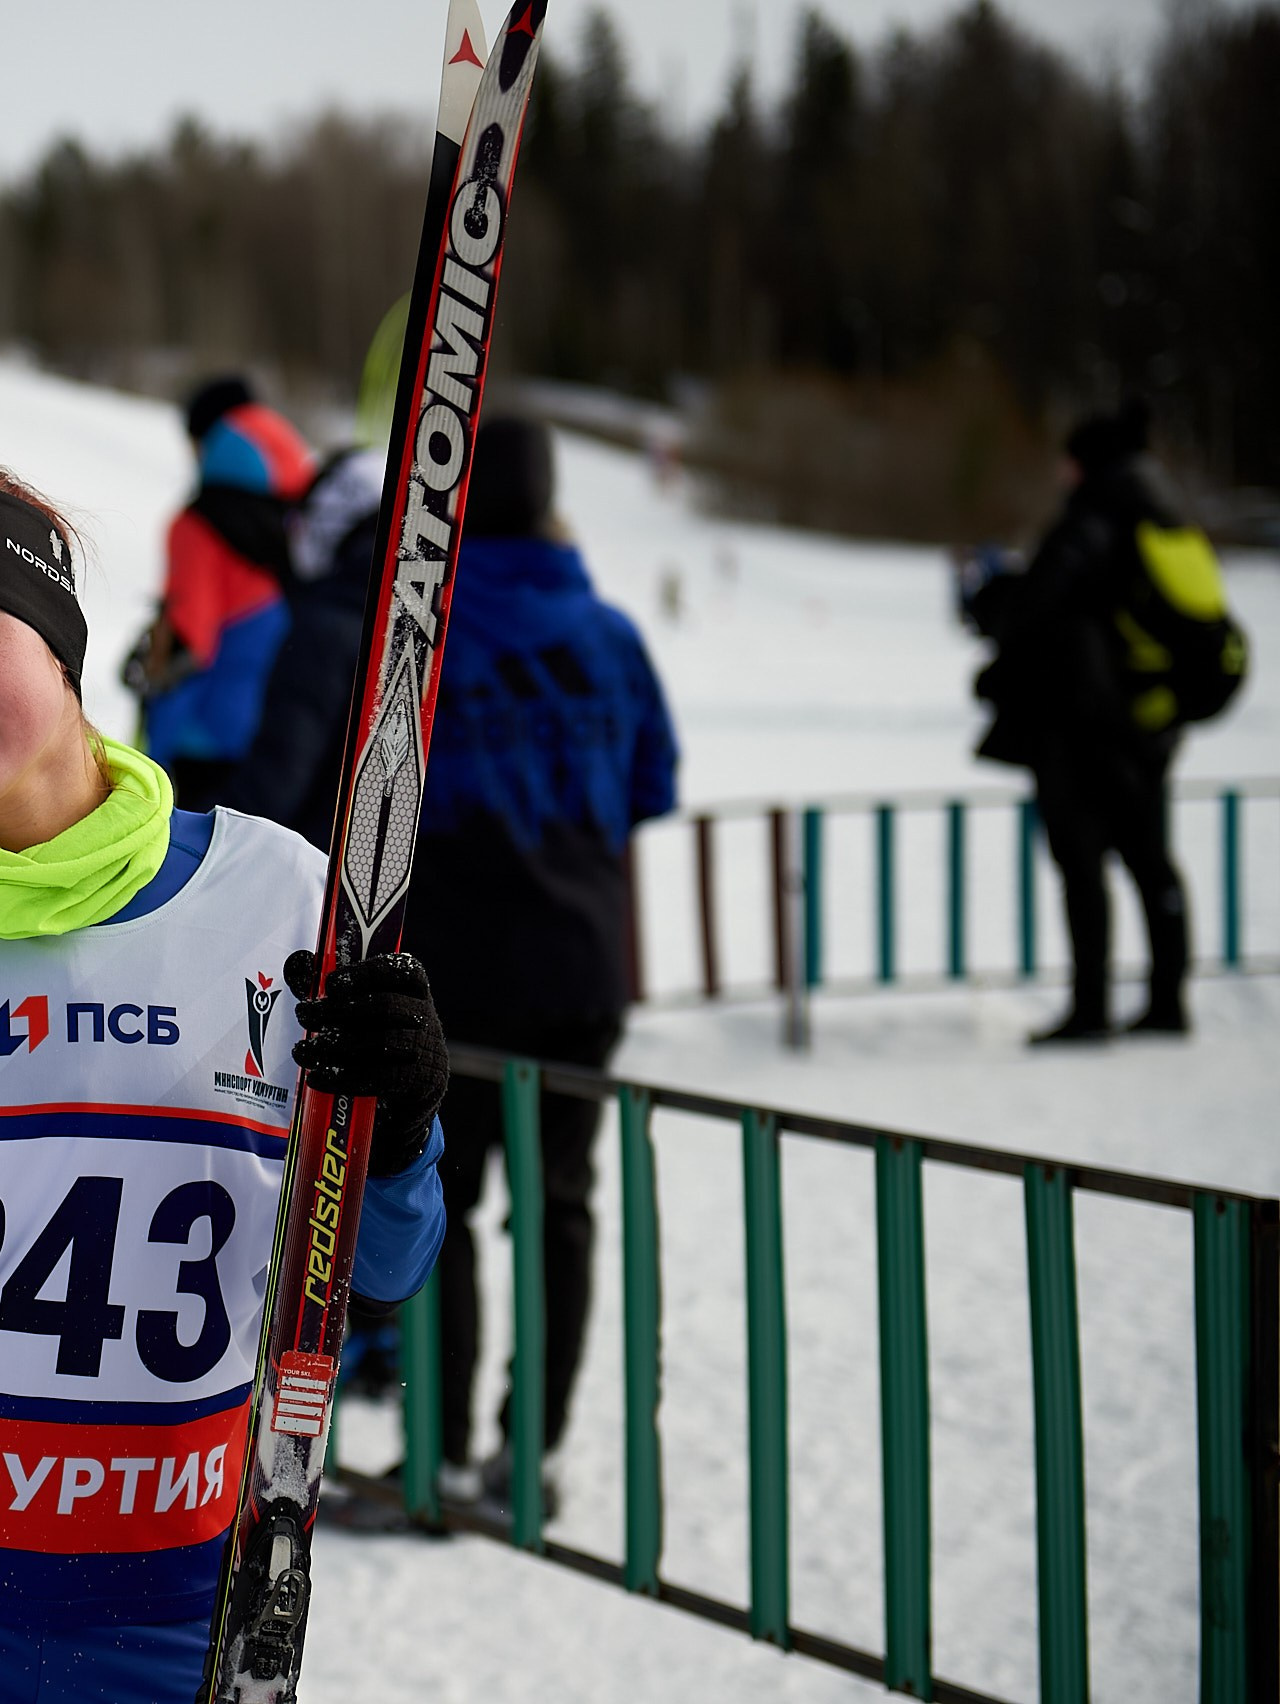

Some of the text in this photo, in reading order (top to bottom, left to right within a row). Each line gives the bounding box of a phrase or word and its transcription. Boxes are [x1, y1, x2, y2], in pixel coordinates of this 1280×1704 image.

[395, 179, 503, 646] ATOMIC
[66, 1002, 180, 1046] ПСБ
[214, 1071, 253, 1093] МИНСПОРТ
[304, 1127, 348, 1308] redster
